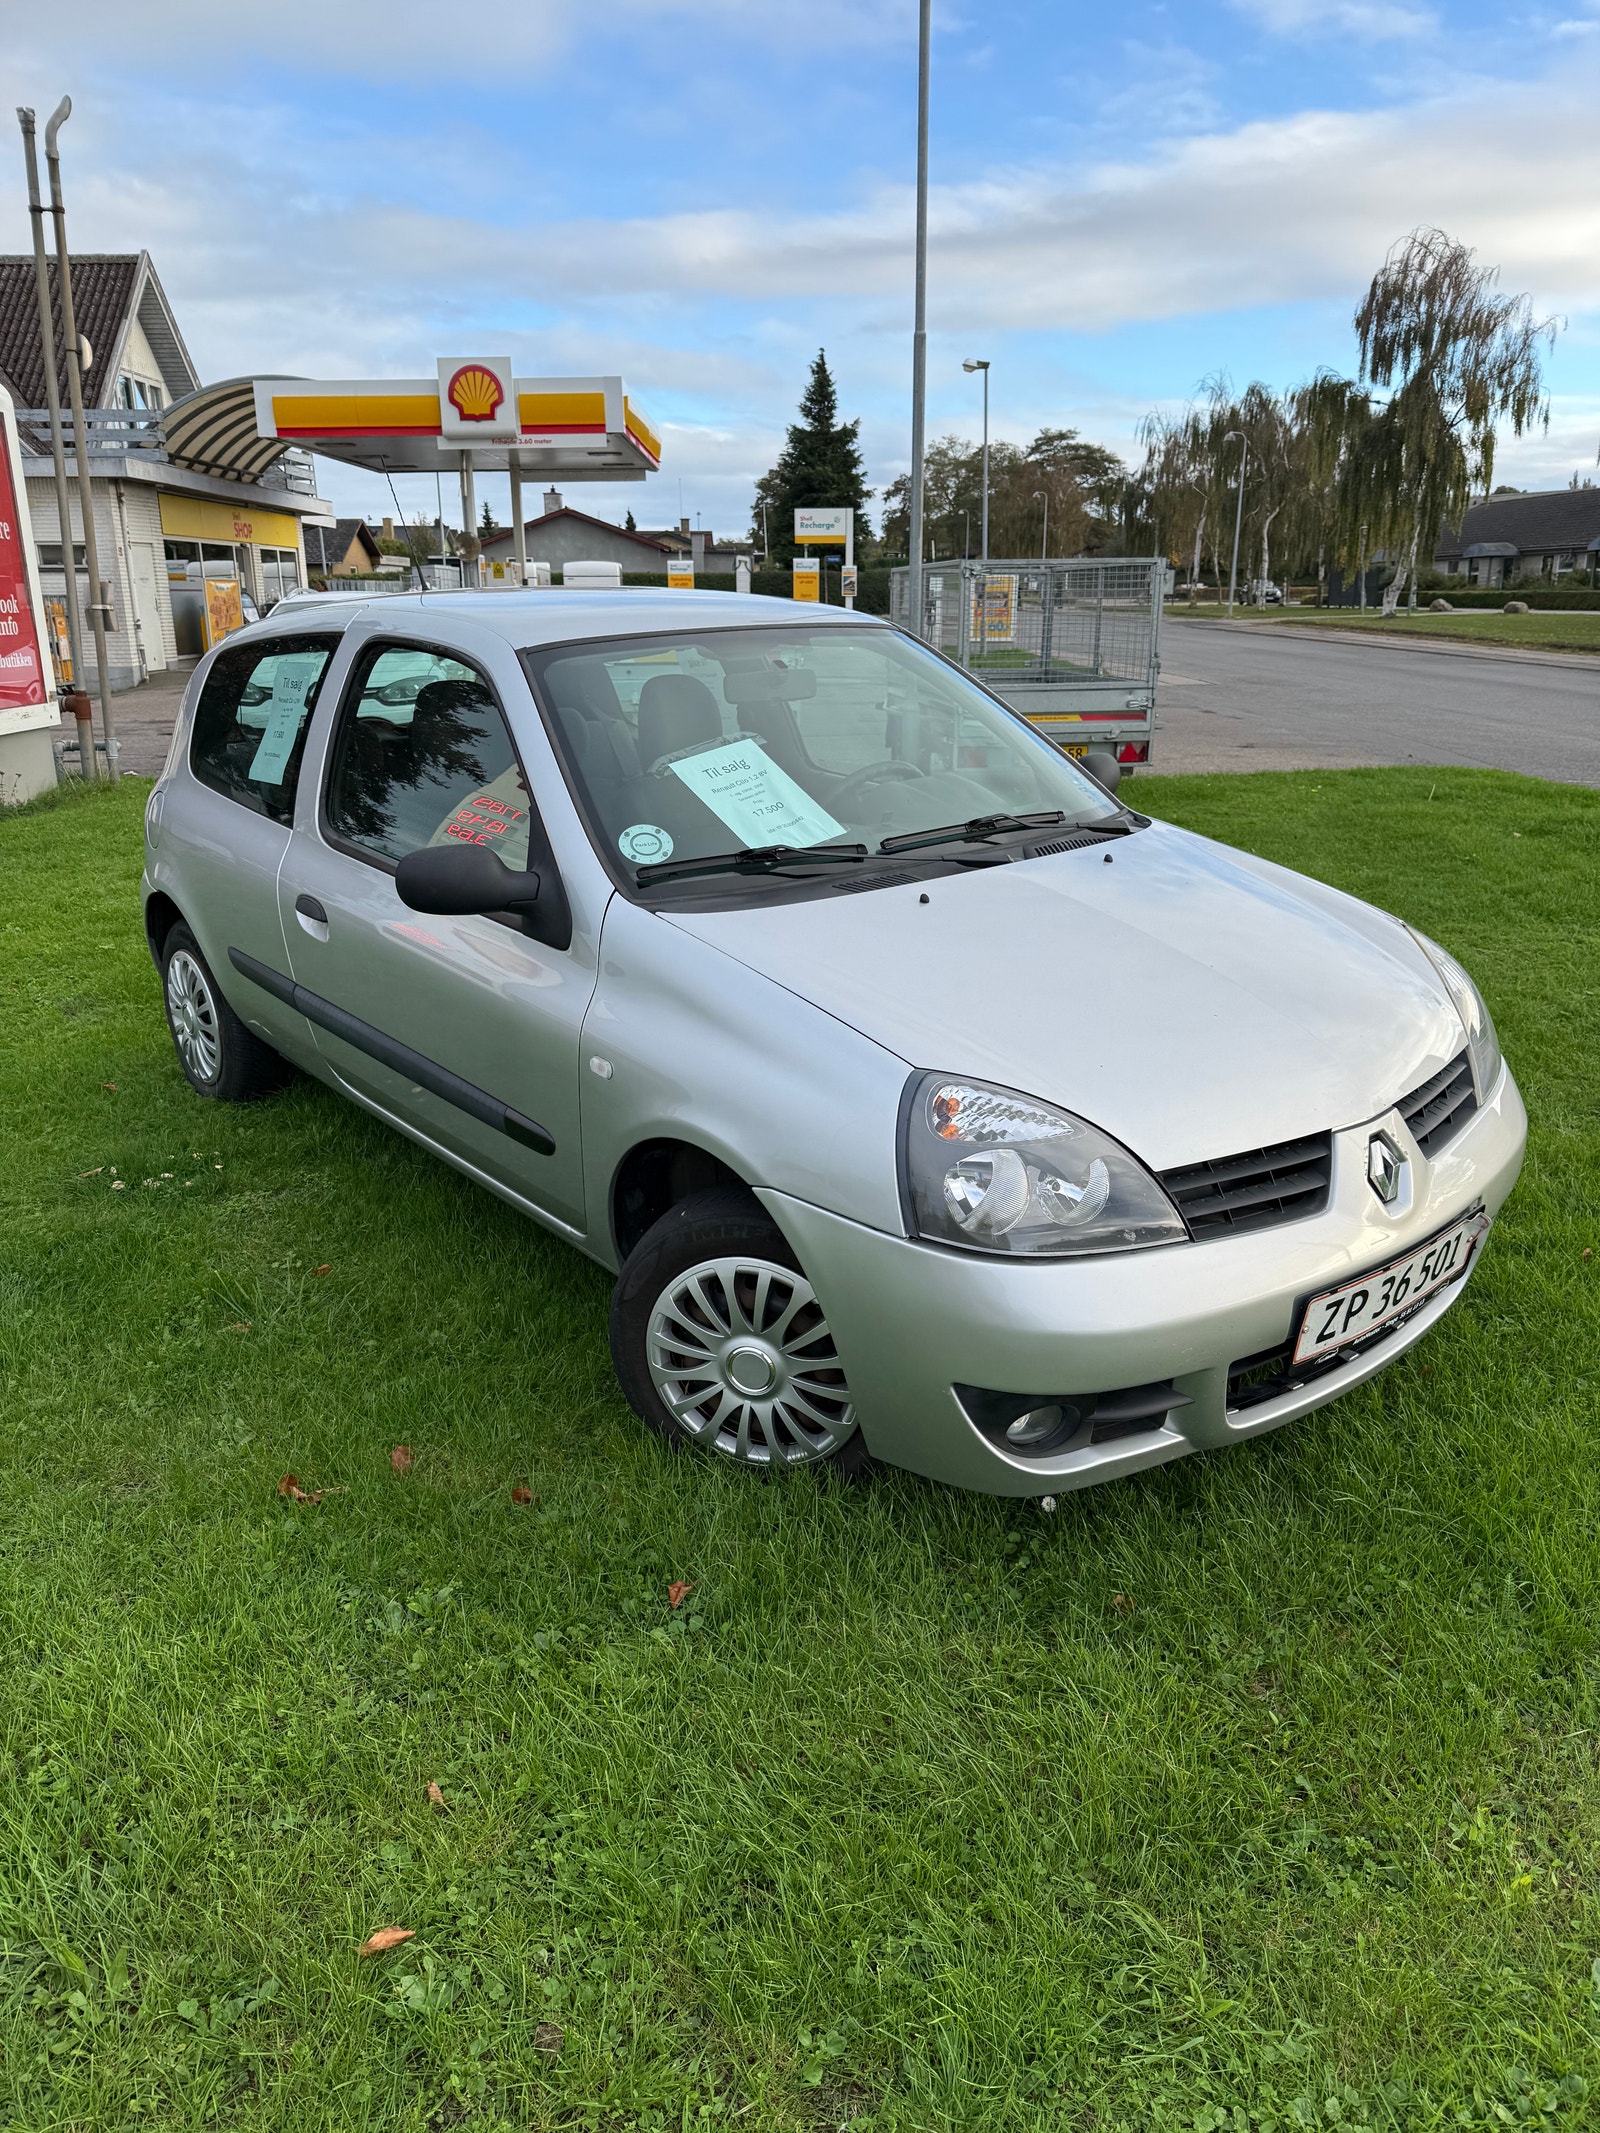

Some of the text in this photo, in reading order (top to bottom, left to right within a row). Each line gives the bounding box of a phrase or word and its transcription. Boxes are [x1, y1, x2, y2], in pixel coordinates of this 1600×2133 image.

[233, 522, 253, 539] SHOP
[800, 521, 835, 530] Recharge
[290, 679, 303, 692] salg
[702, 759, 751, 779] Til salg
[711, 783, 736, 794] Renault
[735, 779, 749, 787] Clio
[752, 801, 784, 817] 17.500
[1315, 1231, 1463, 1344] ZP 36 501
